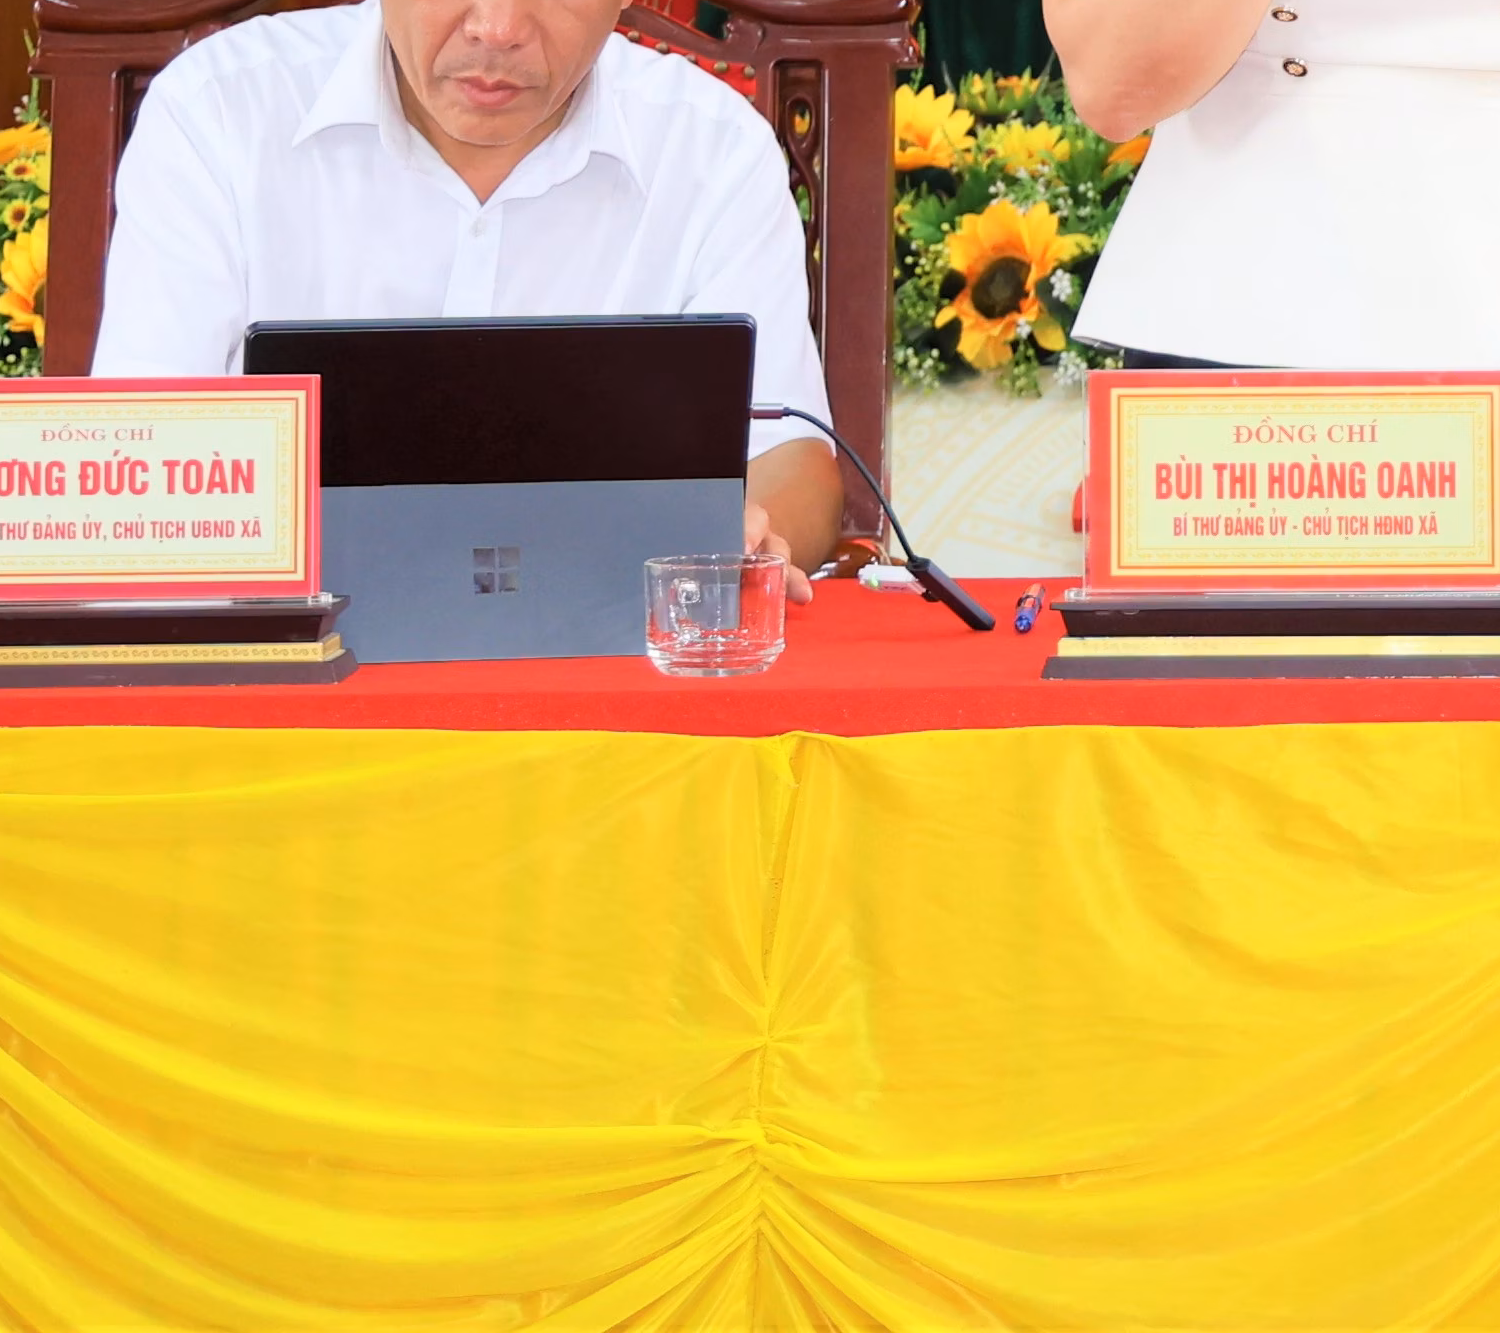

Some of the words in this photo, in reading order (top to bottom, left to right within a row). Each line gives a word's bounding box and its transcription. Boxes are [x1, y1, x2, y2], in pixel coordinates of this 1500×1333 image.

[41, 423, 106, 441] ĐỒNG
[115, 424, 153, 441] CHÍ
[1233, 416, 1317, 443] ĐỒNG
[1327, 420, 1378, 443] CHÍ
[79, 450, 148, 496] ĐỨC
[162, 452, 254, 494] TOÀN
[1155, 455, 1202, 500] BÙI
[1213, 463, 1256, 508] THỊ
[1268, 454, 1366, 499] HOÀNG
[1377, 462, 1456, 498] OANH
[33, 515, 76, 539] ĐẢNG
[83, 514, 107, 542] ỦY,
[113, 514, 144, 539] CHỦ
[152, 521, 185, 543] TỊCH
[192, 520, 235, 538] UBND
[241, 517, 261, 538] XÃ
[1174, 513, 1187, 536] BÍ
[1193, 515, 1221, 536] THƯ
[1224, 508, 1264, 536] ĐẢNG
[1270, 508, 1287, 536] ỦY
[1303, 507, 1331, 536] CHỦ
[1337, 516, 1368, 540] TỊCH
[1374, 516, 1412, 535] HĐND
[1419, 512, 1438, 535] XÃ
